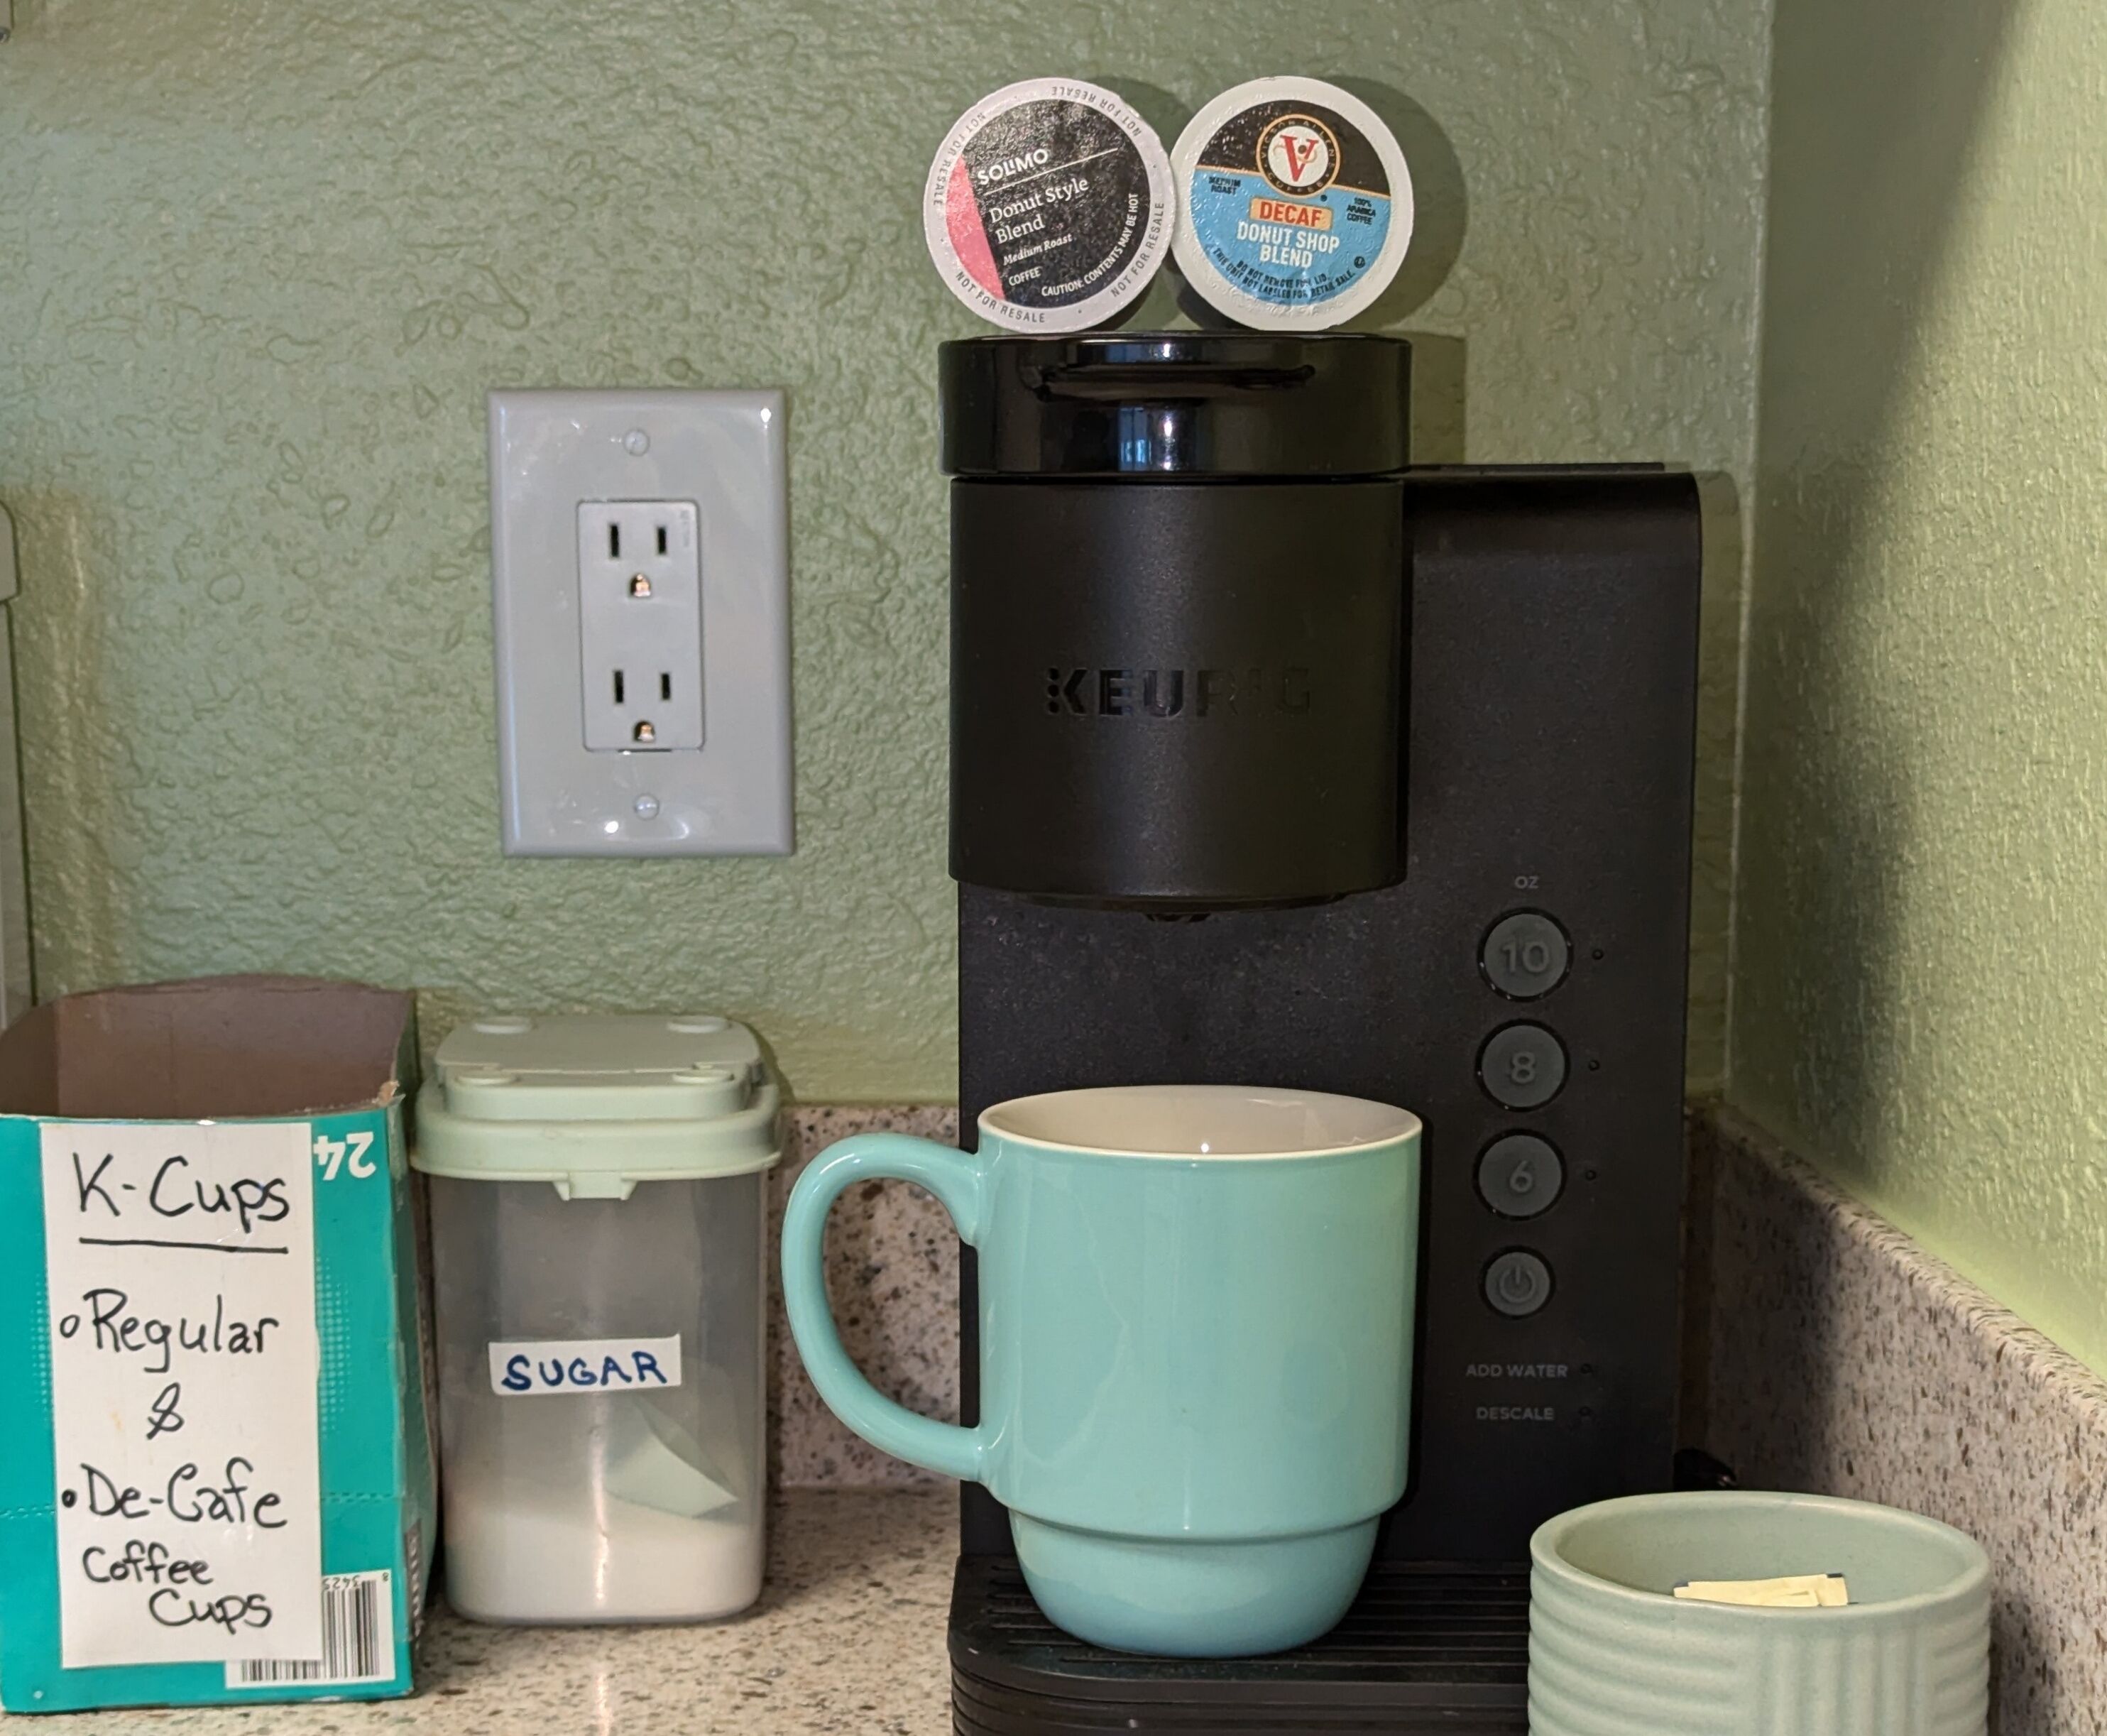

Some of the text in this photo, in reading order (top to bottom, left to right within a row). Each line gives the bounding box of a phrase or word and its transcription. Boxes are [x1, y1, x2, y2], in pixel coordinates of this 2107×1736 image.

[965, 113, 986, 133] NOT
[1051, 86, 1142, 136] NOT FOR RESALE
[977, 148, 1049, 186] SOLIMO
[1280, 134, 1320, 182] V
[934, 160, 951, 206] RESALE
[990, 177, 1090, 224] Donut Style
[995, 214, 1046, 245] Blend
[1259, 201, 1323, 227] DECAF
[1003, 233, 1073, 266] Medium Roast
[1041, 193, 1139, 297] CAUTION: CONTENTS MAY BE HOT
[1110, 202, 1165, 297] NOT FOR RESALE
[1237, 221, 1341, 255] DONUT SHOP
[1236, 260, 1248, 272] DO
[1248, 268, 1264, 281] NOT
[1259, 244, 1313, 269] BLEND
[1008, 266, 1042, 286] COFFEE
[1242, 276, 1259, 288] NOT
[956, 271, 1046, 323] NOT FOR RESALE
[1514, 875, 1539, 890] OZ
[1501, 941, 1549, 974] 10
[1509, 1051, 1536, 1085] 8
[313, 1132, 377, 1180] 24
[72, 1152, 290, 1235] K-Cups
[1509, 1160, 1534, 1193] 6
[82, 1289, 280, 1373] Regular
[501, 1350, 668, 1391] SUGAR
[1466, 1364, 1568, 1377] ADD WATER
[1476, 1407, 1555, 1420] DESCALE
[80, 1456, 290, 1529] De-Cafe
[82, 1540, 214, 1585] Coffee
[148, 1588, 273, 1635] Cups
